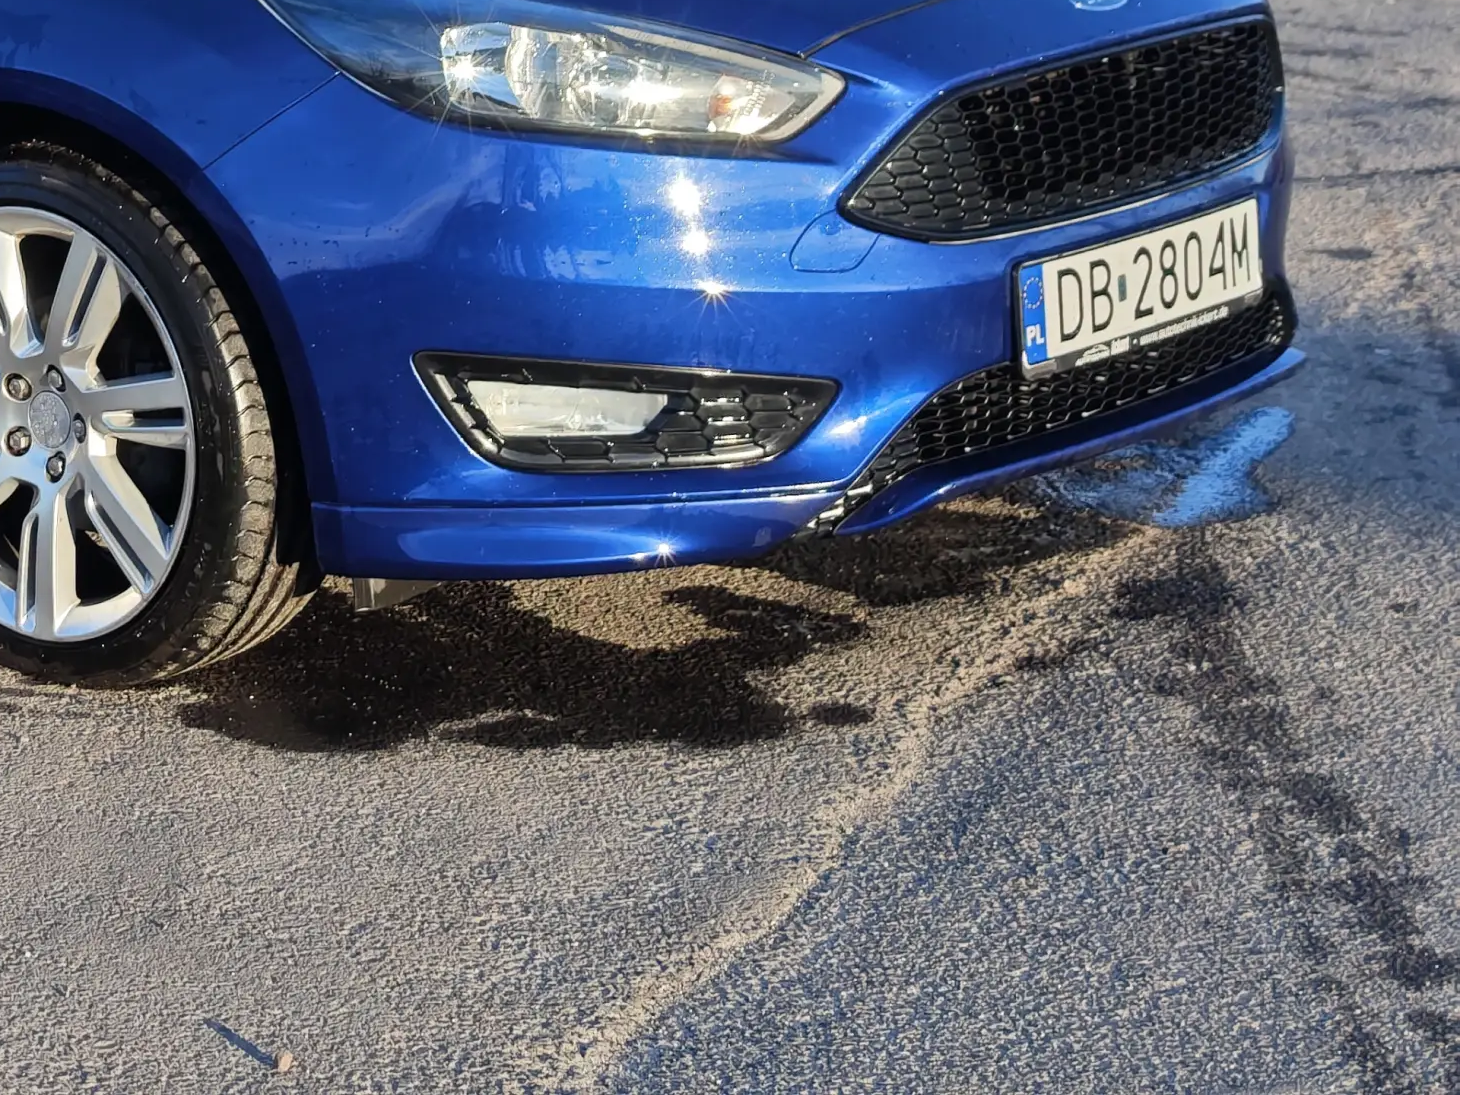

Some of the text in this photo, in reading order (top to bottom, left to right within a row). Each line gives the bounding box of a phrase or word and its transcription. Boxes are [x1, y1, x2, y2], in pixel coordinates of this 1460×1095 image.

[1056, 212, 1251, 343] DB 2804M
[1026, 323, 1045, 347] PL
